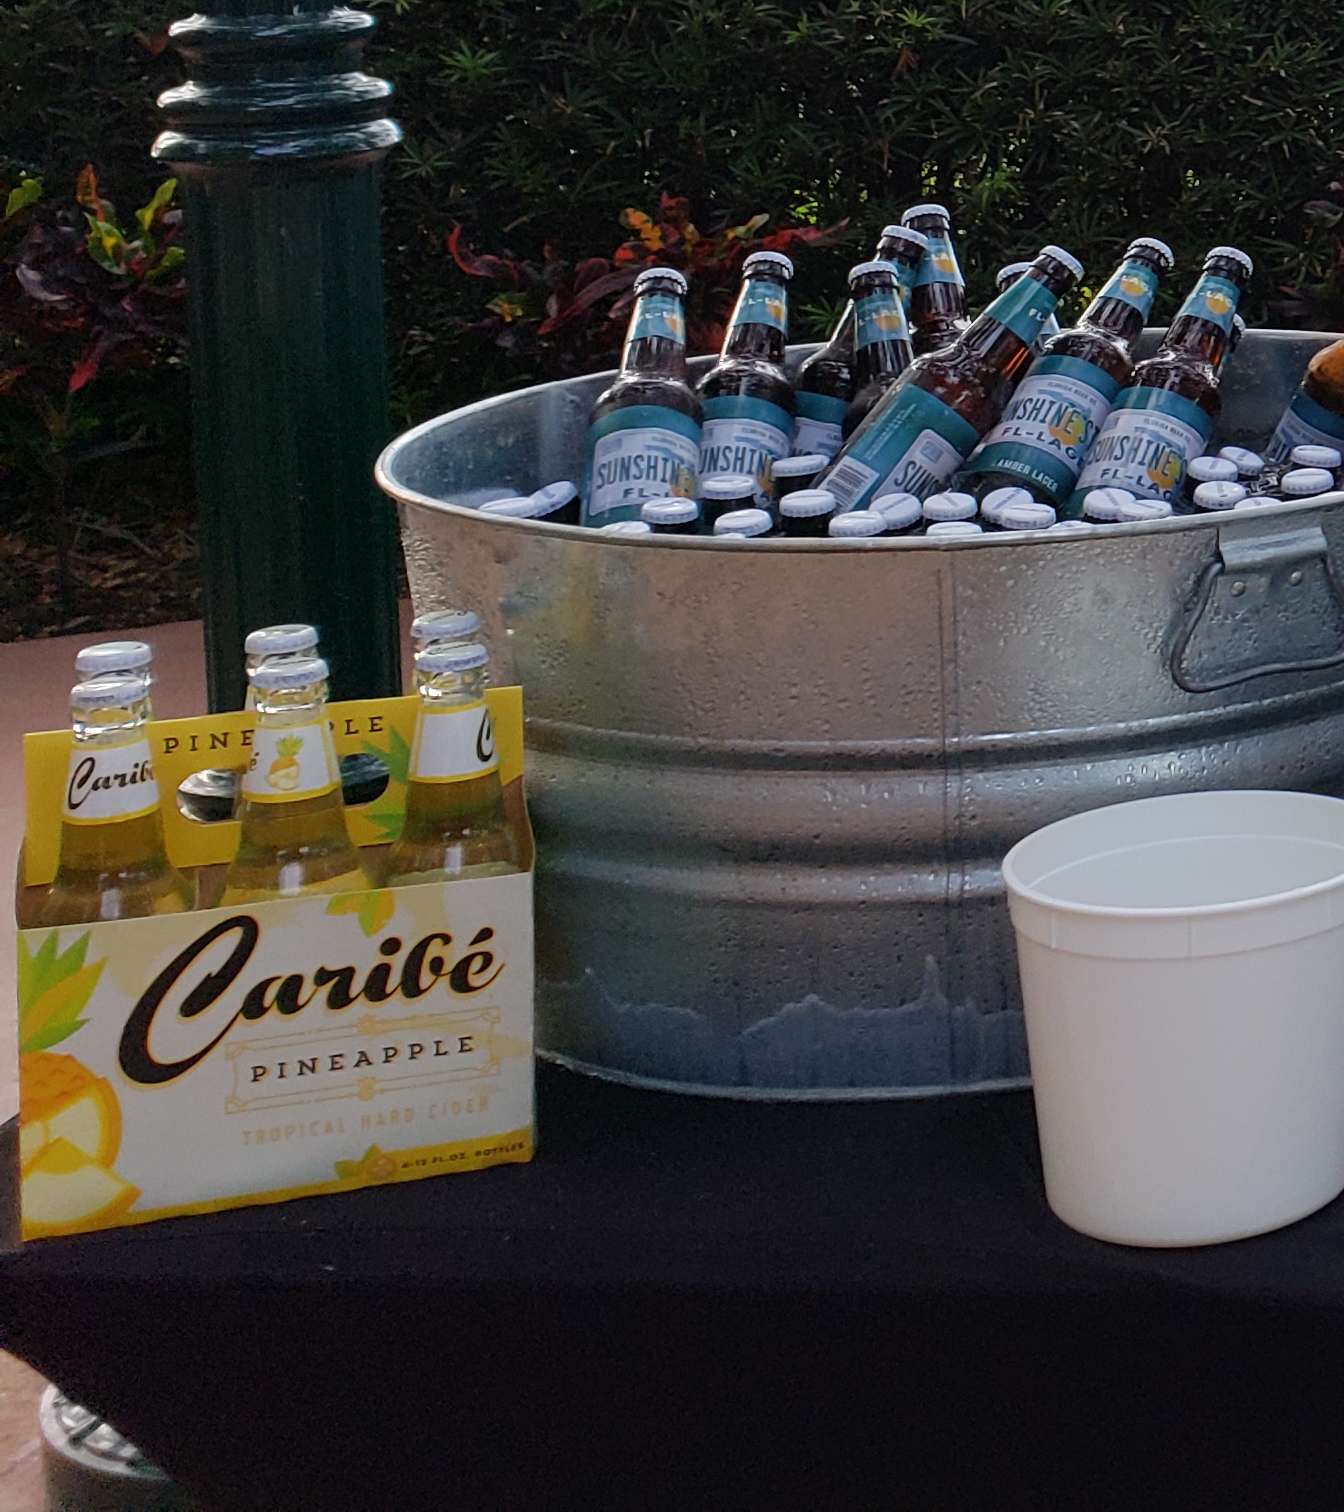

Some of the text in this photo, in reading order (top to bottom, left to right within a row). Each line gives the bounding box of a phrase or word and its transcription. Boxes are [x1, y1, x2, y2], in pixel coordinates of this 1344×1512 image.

[997, 458, 1059, 493] AMBER LAGER
[118, 914, 506, 1085] Caribé
[251, 1035, 475, 1083] PINEAPPLE
[243, 1094, 490, 1147] TROPICAL HARD CIDER
[474, 1142, 525, 1157] BOTTLES
